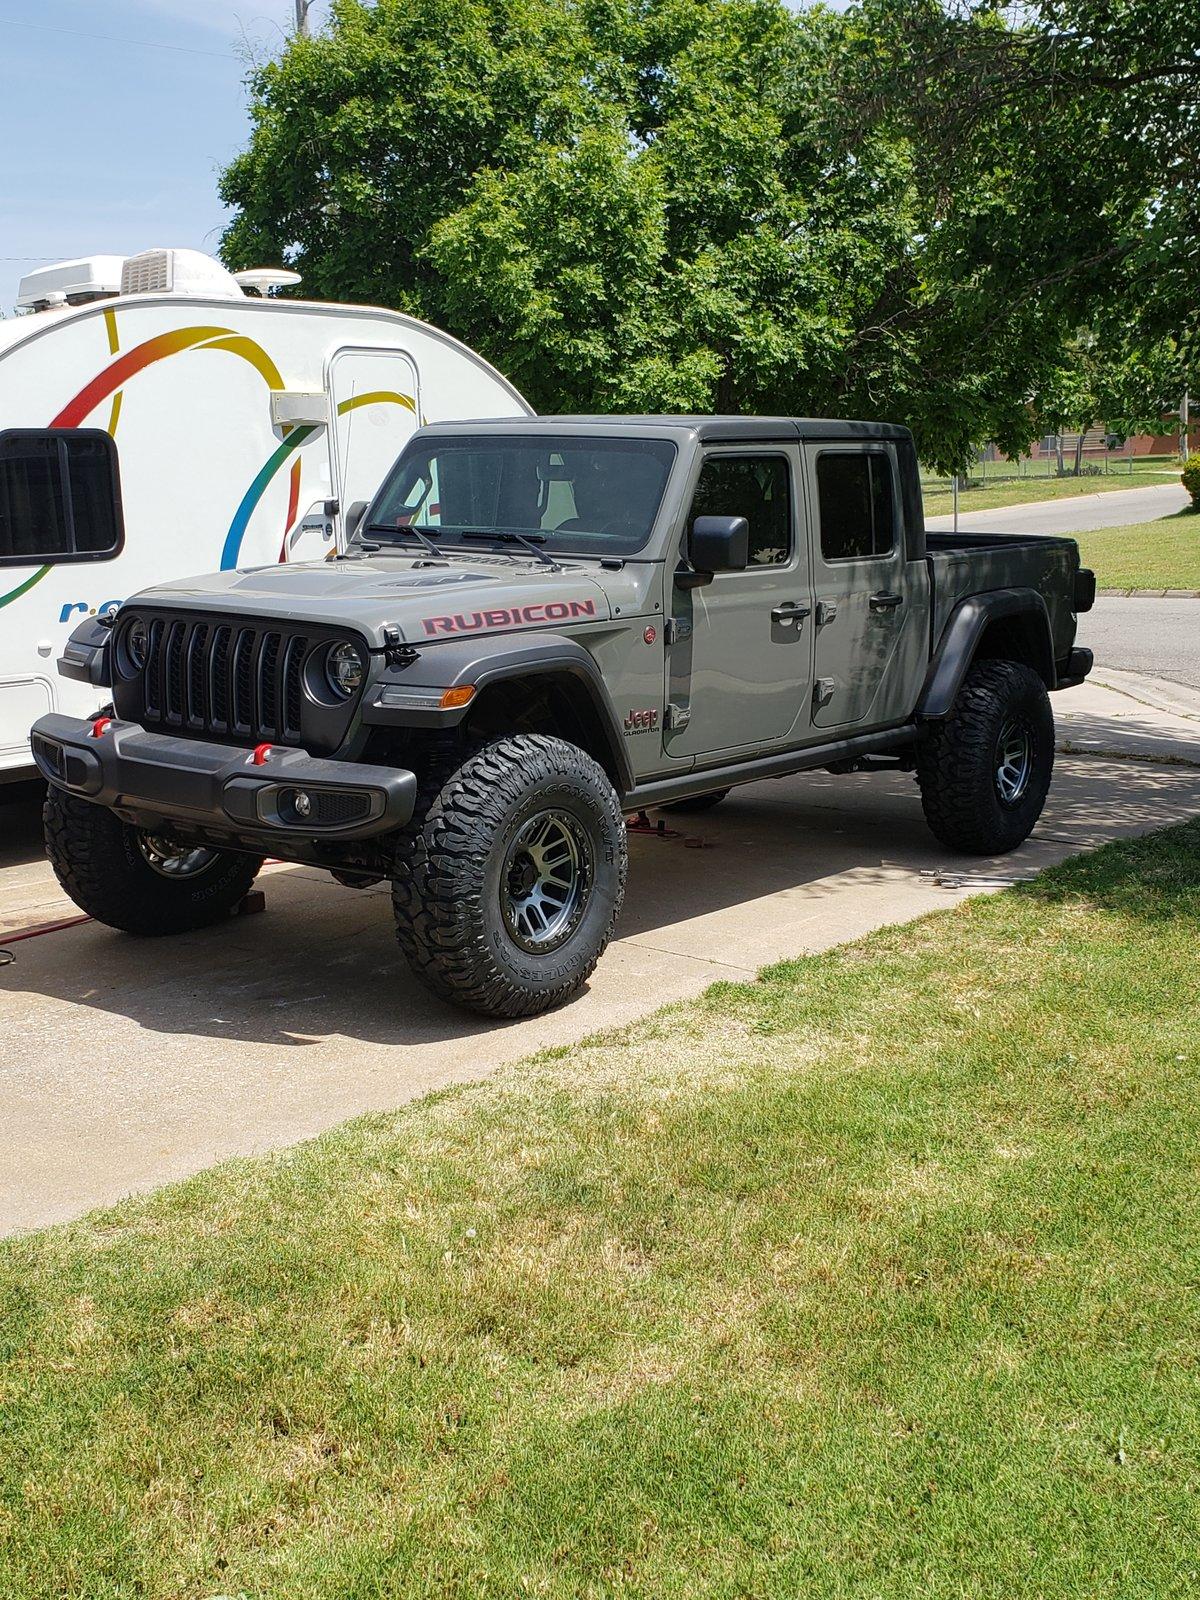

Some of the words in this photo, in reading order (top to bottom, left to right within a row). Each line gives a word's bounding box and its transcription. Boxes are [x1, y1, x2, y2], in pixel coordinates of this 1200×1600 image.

[422, 600, 596, 634] RUBICON
[624, 708, 658, 730] Jeep
[623, 727, 660, 737] GLADIATOR
